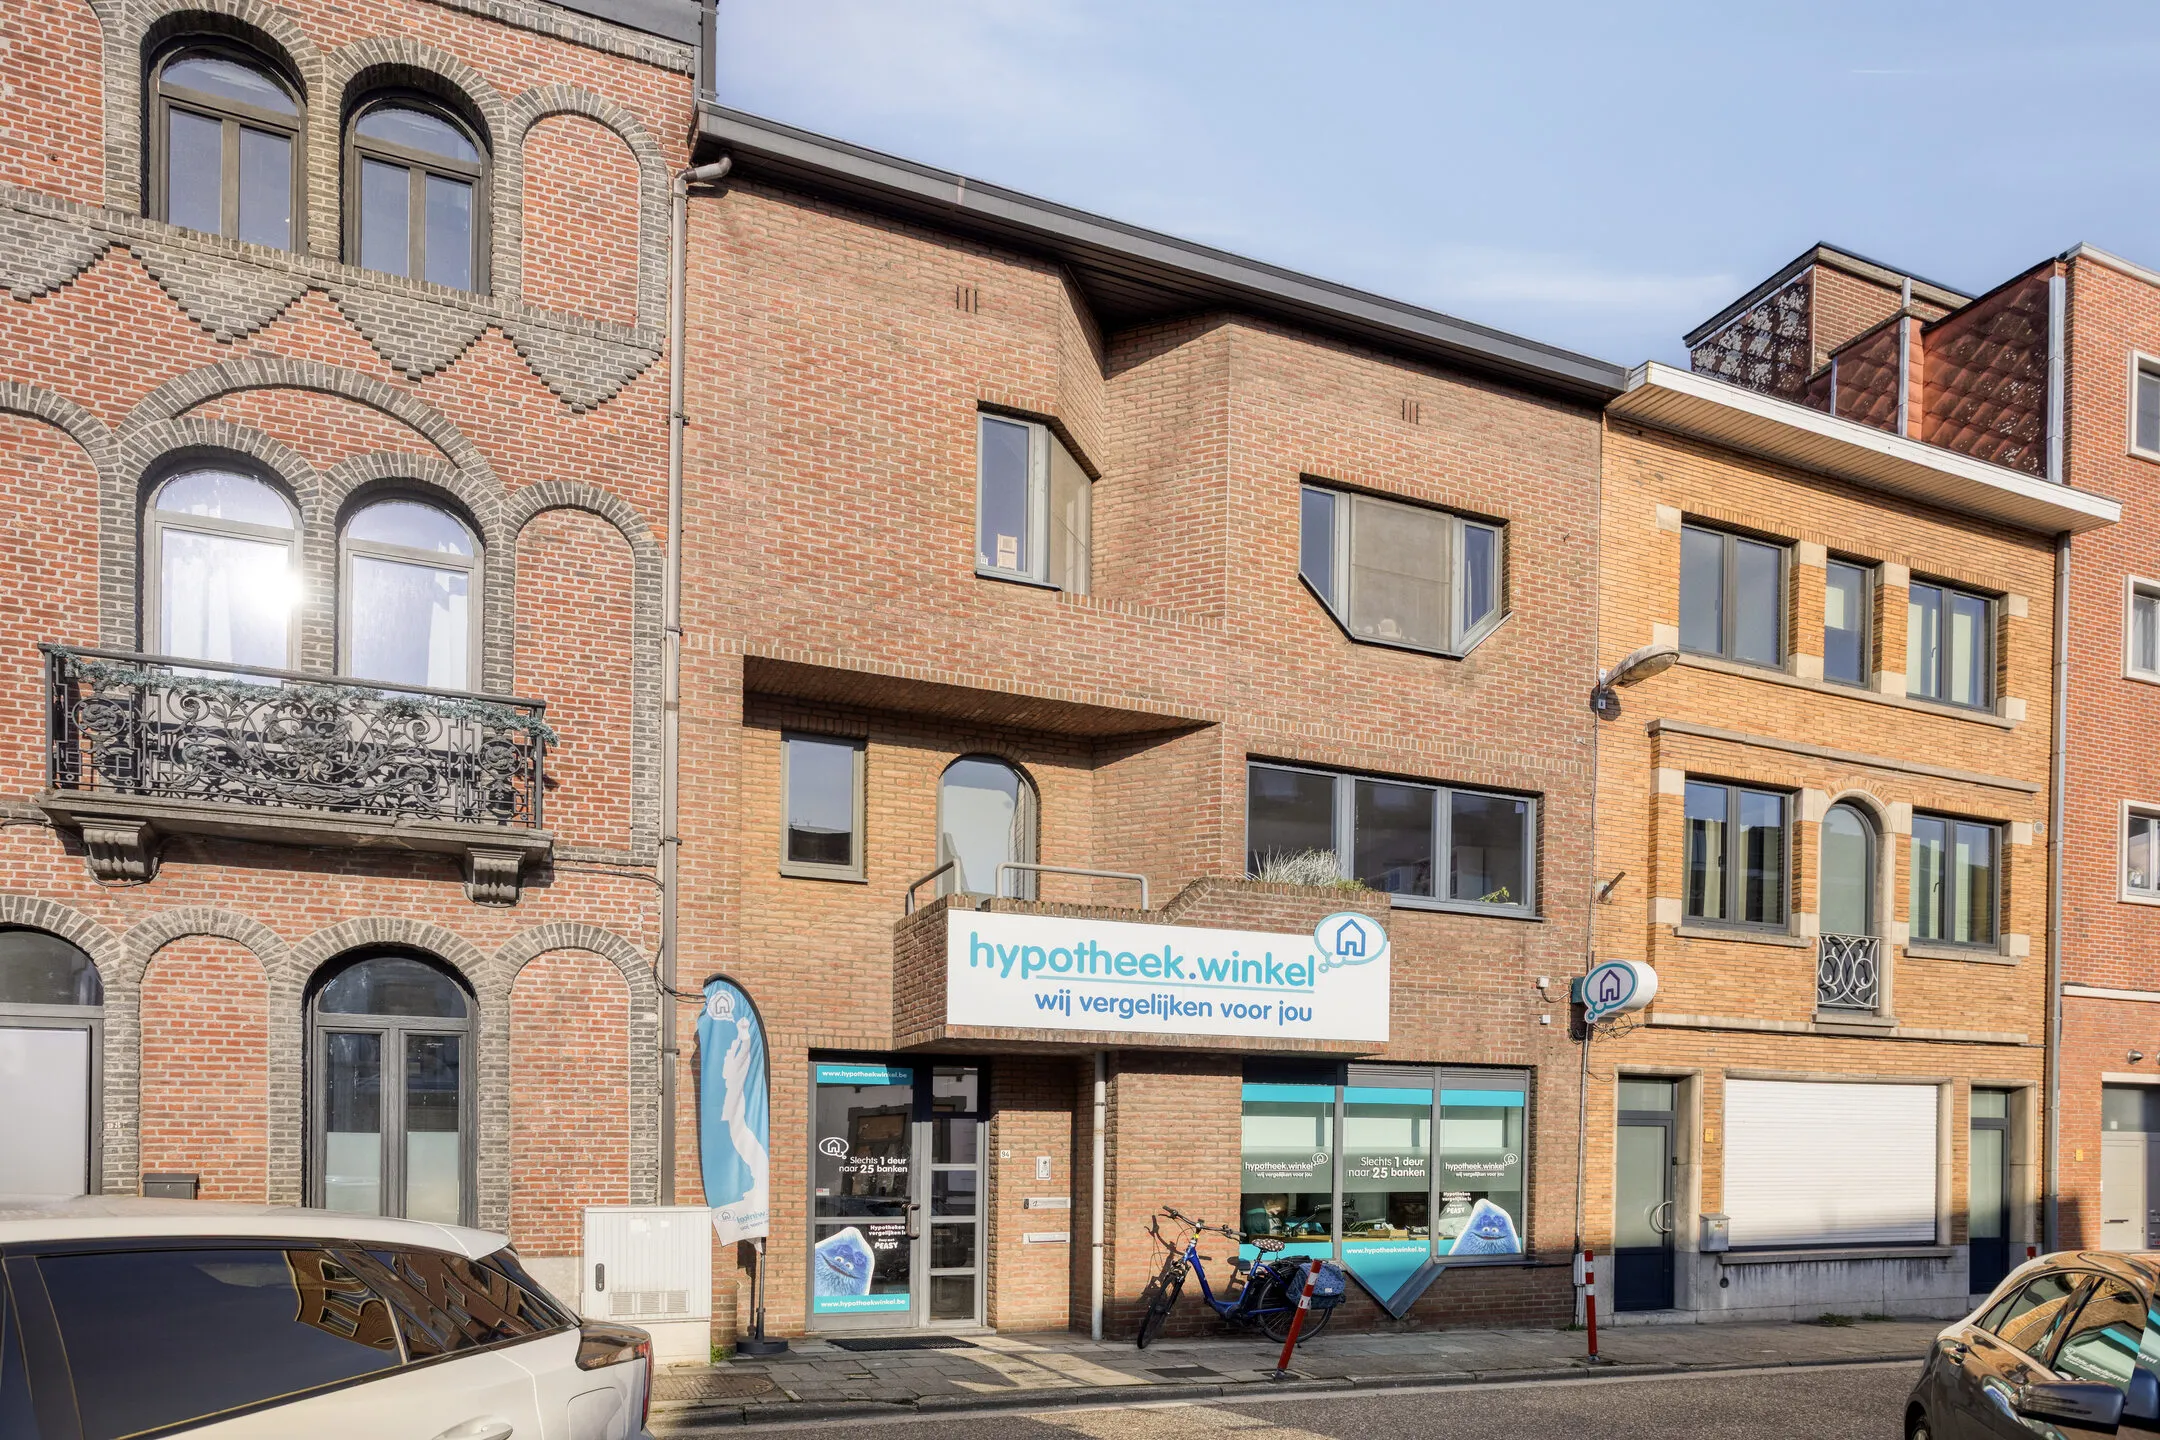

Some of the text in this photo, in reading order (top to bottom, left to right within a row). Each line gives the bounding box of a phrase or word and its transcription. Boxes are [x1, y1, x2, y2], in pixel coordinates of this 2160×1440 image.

[970, 931, 1315, 987] hypotheek.winkel
[1034, 989, 1313, 1026] wij vergelijken voor jou
[821, 1069, 908, 1079] www.hypotheekwinkel.be
[850, 1156, 907, 1165] Slechts 1 deur
[1360, 1156, 1424, 1167] Slechts 1 deur
[860, 1165, 875, 1173] 25
[1245, 1162, 1313, 1172] hypotheek.winkel
[1445, 1162, 1505, 1171] hypotheek.winkel
[1348, 1167, 1425, 1178] naar 25 banken
[1346, 1241, 1427, 1254] www.hypotheekwinkel.be
[821, 1299, 906, 1309] www.hypotheekwinkel.be
